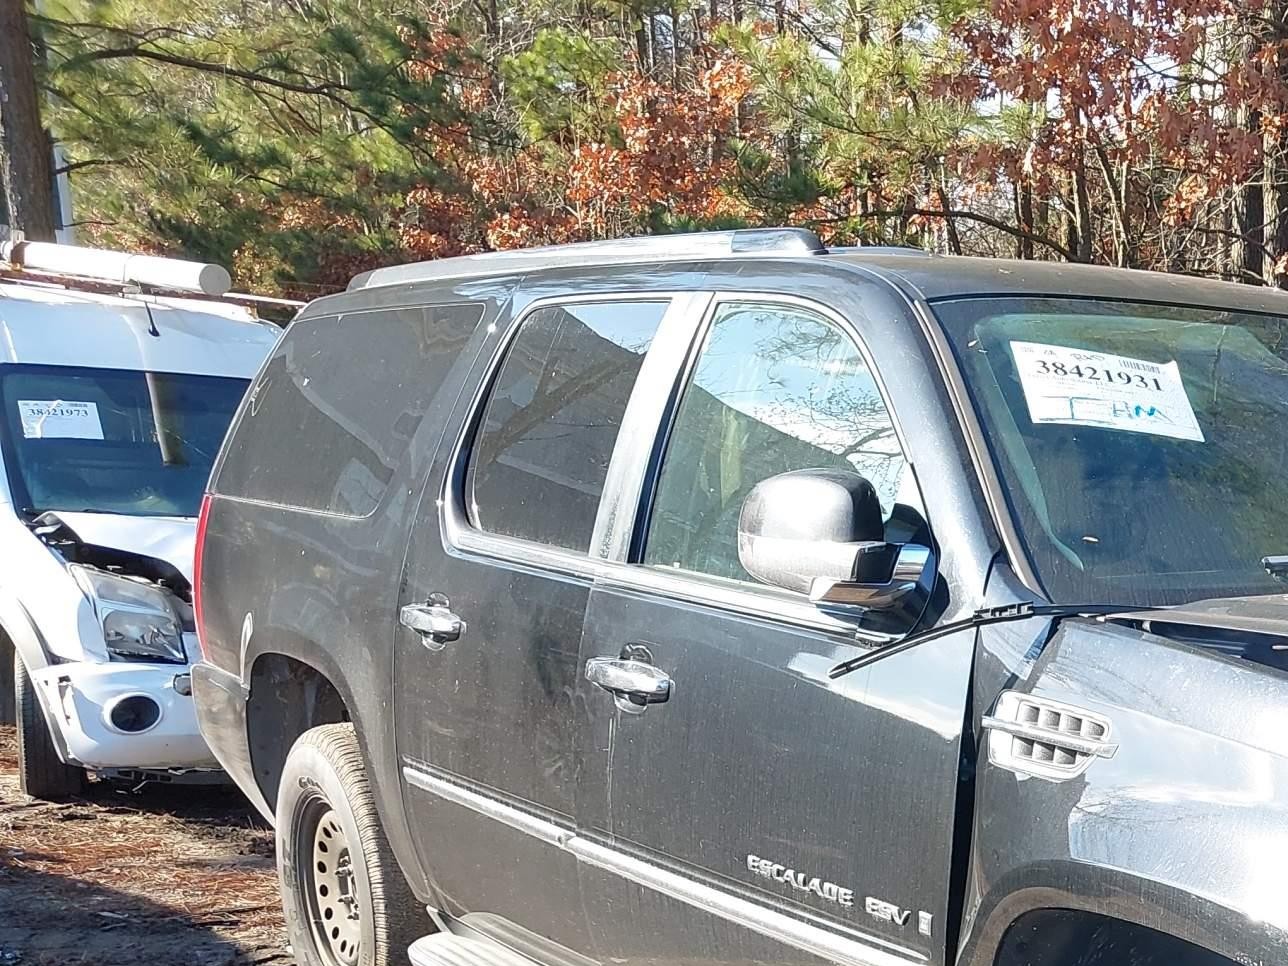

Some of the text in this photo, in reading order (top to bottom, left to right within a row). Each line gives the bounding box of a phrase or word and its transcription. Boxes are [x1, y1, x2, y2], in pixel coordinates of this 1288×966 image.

[1035, 360, 1164, 392] 38421931
[746, 853, 855, 907] ESCALADE
[864, 896, 912, 926] ESV
